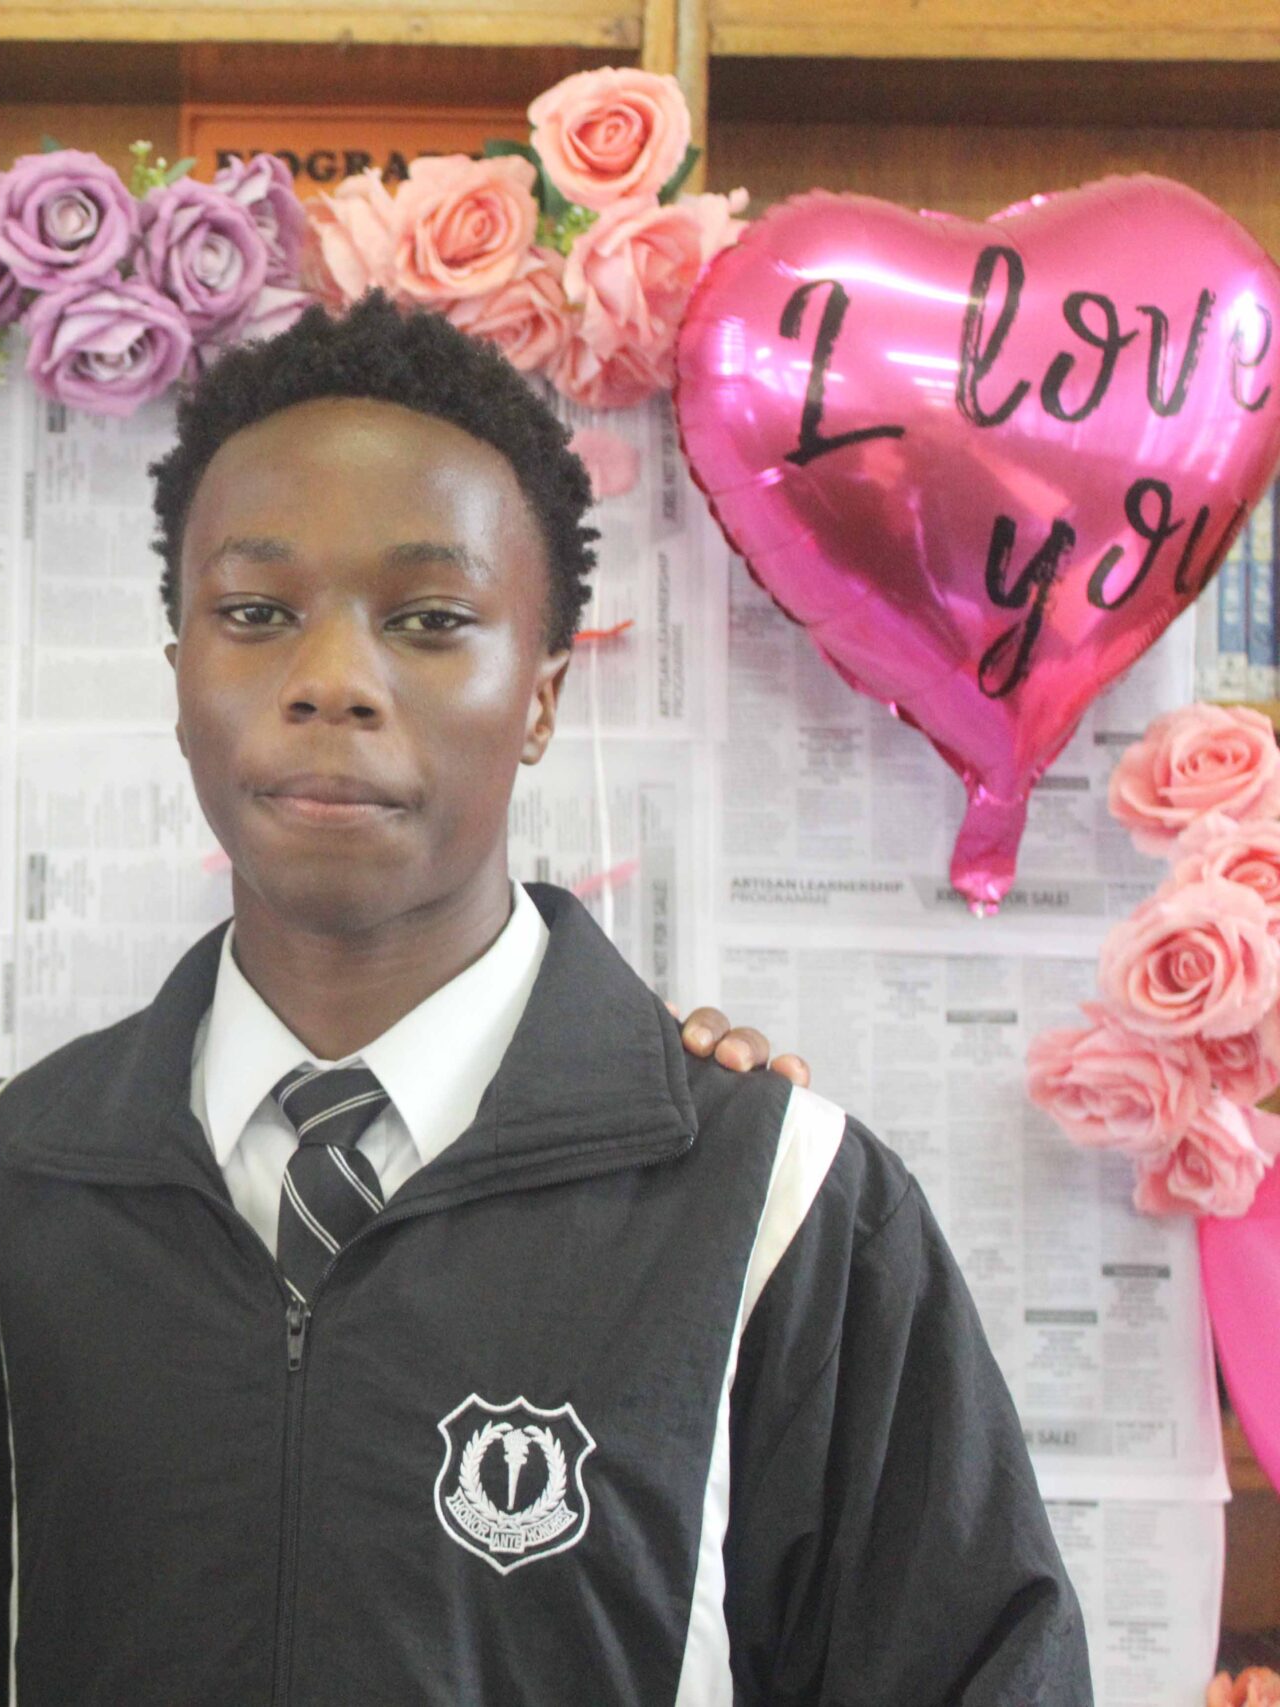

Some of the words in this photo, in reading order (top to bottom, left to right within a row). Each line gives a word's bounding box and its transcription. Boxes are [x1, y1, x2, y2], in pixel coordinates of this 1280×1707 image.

[956, 245, 1273, 428] love
[977, 477, 1250, 699] you
[731, 876, 798, 890] ARTISAN
[799, 878, 905, 893] LEARNERSHIP
[451, 1498, 490, 1538] HONOR
[494, 1532, 521, 1549] ANTE
